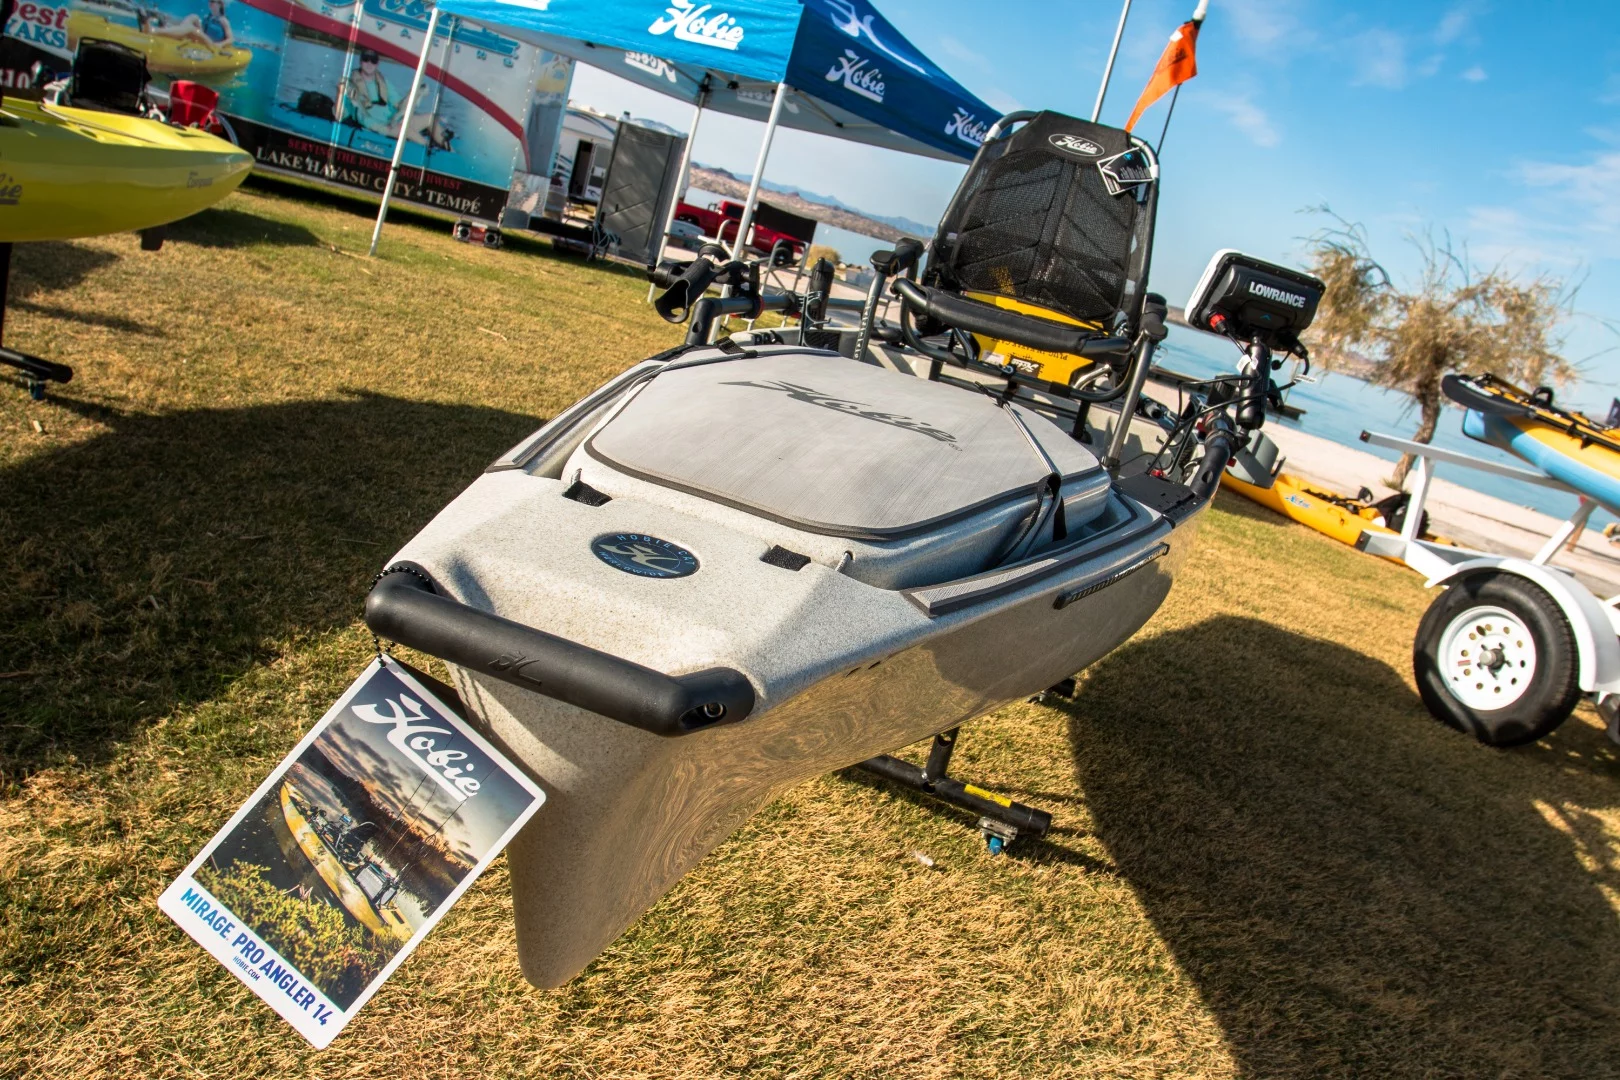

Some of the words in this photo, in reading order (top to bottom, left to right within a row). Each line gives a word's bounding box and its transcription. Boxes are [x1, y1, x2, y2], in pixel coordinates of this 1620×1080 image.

[647, 0, 744, 50] Hobie
[825, 49, 885, 103] Hobie
[360, 156, 393, 172] DESER
[1055, 135, 1098, 154] Hobie
[256, 146, 302, 169] LAKE
[374, 176, 414, 197] CTY
[426, 189, 481, 215] TEMPE
[1249, 281, 1306, 308] LOWRANCE
[717, 380, 957, 443] Hobie
[616, 534, 673, 549] HOBIE
[678, 550, 695, 565] CAT
[351, 693, 481, 803] Hobie
[180, 887, 236, 939] MIRAGE
[231, 932, 265, 965] PRO
[259, 958, 316, 1011] ANGLER
[312, 1003, 334, 1026] 14
[232, 955, 261, 982] HOBIE.COM
